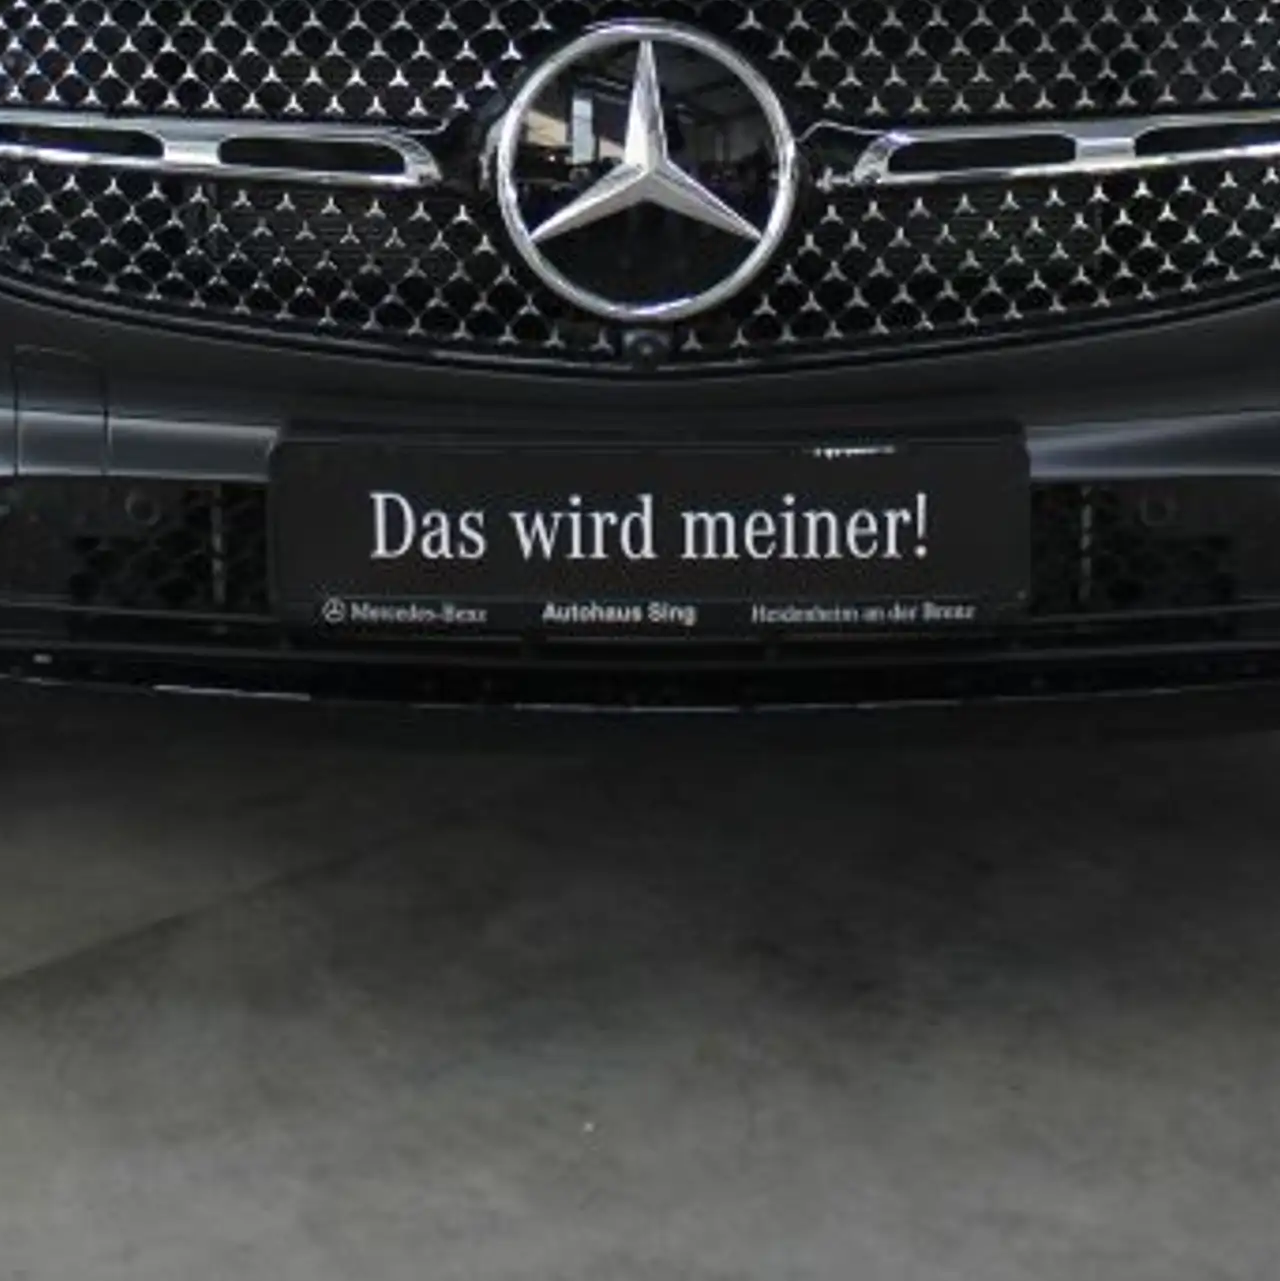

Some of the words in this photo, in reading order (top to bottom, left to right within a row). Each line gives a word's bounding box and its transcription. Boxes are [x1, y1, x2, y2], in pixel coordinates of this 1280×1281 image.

[370, 492, 487, 560] Das
[509, 493, 657, 560] wird
[681, 492, 928, 560] meiner!
[350, 602, 488, 624] Mercedes-Benz
[541, 600, 643, 623] Autohaus
[646, 601, 696, 627] Sing
